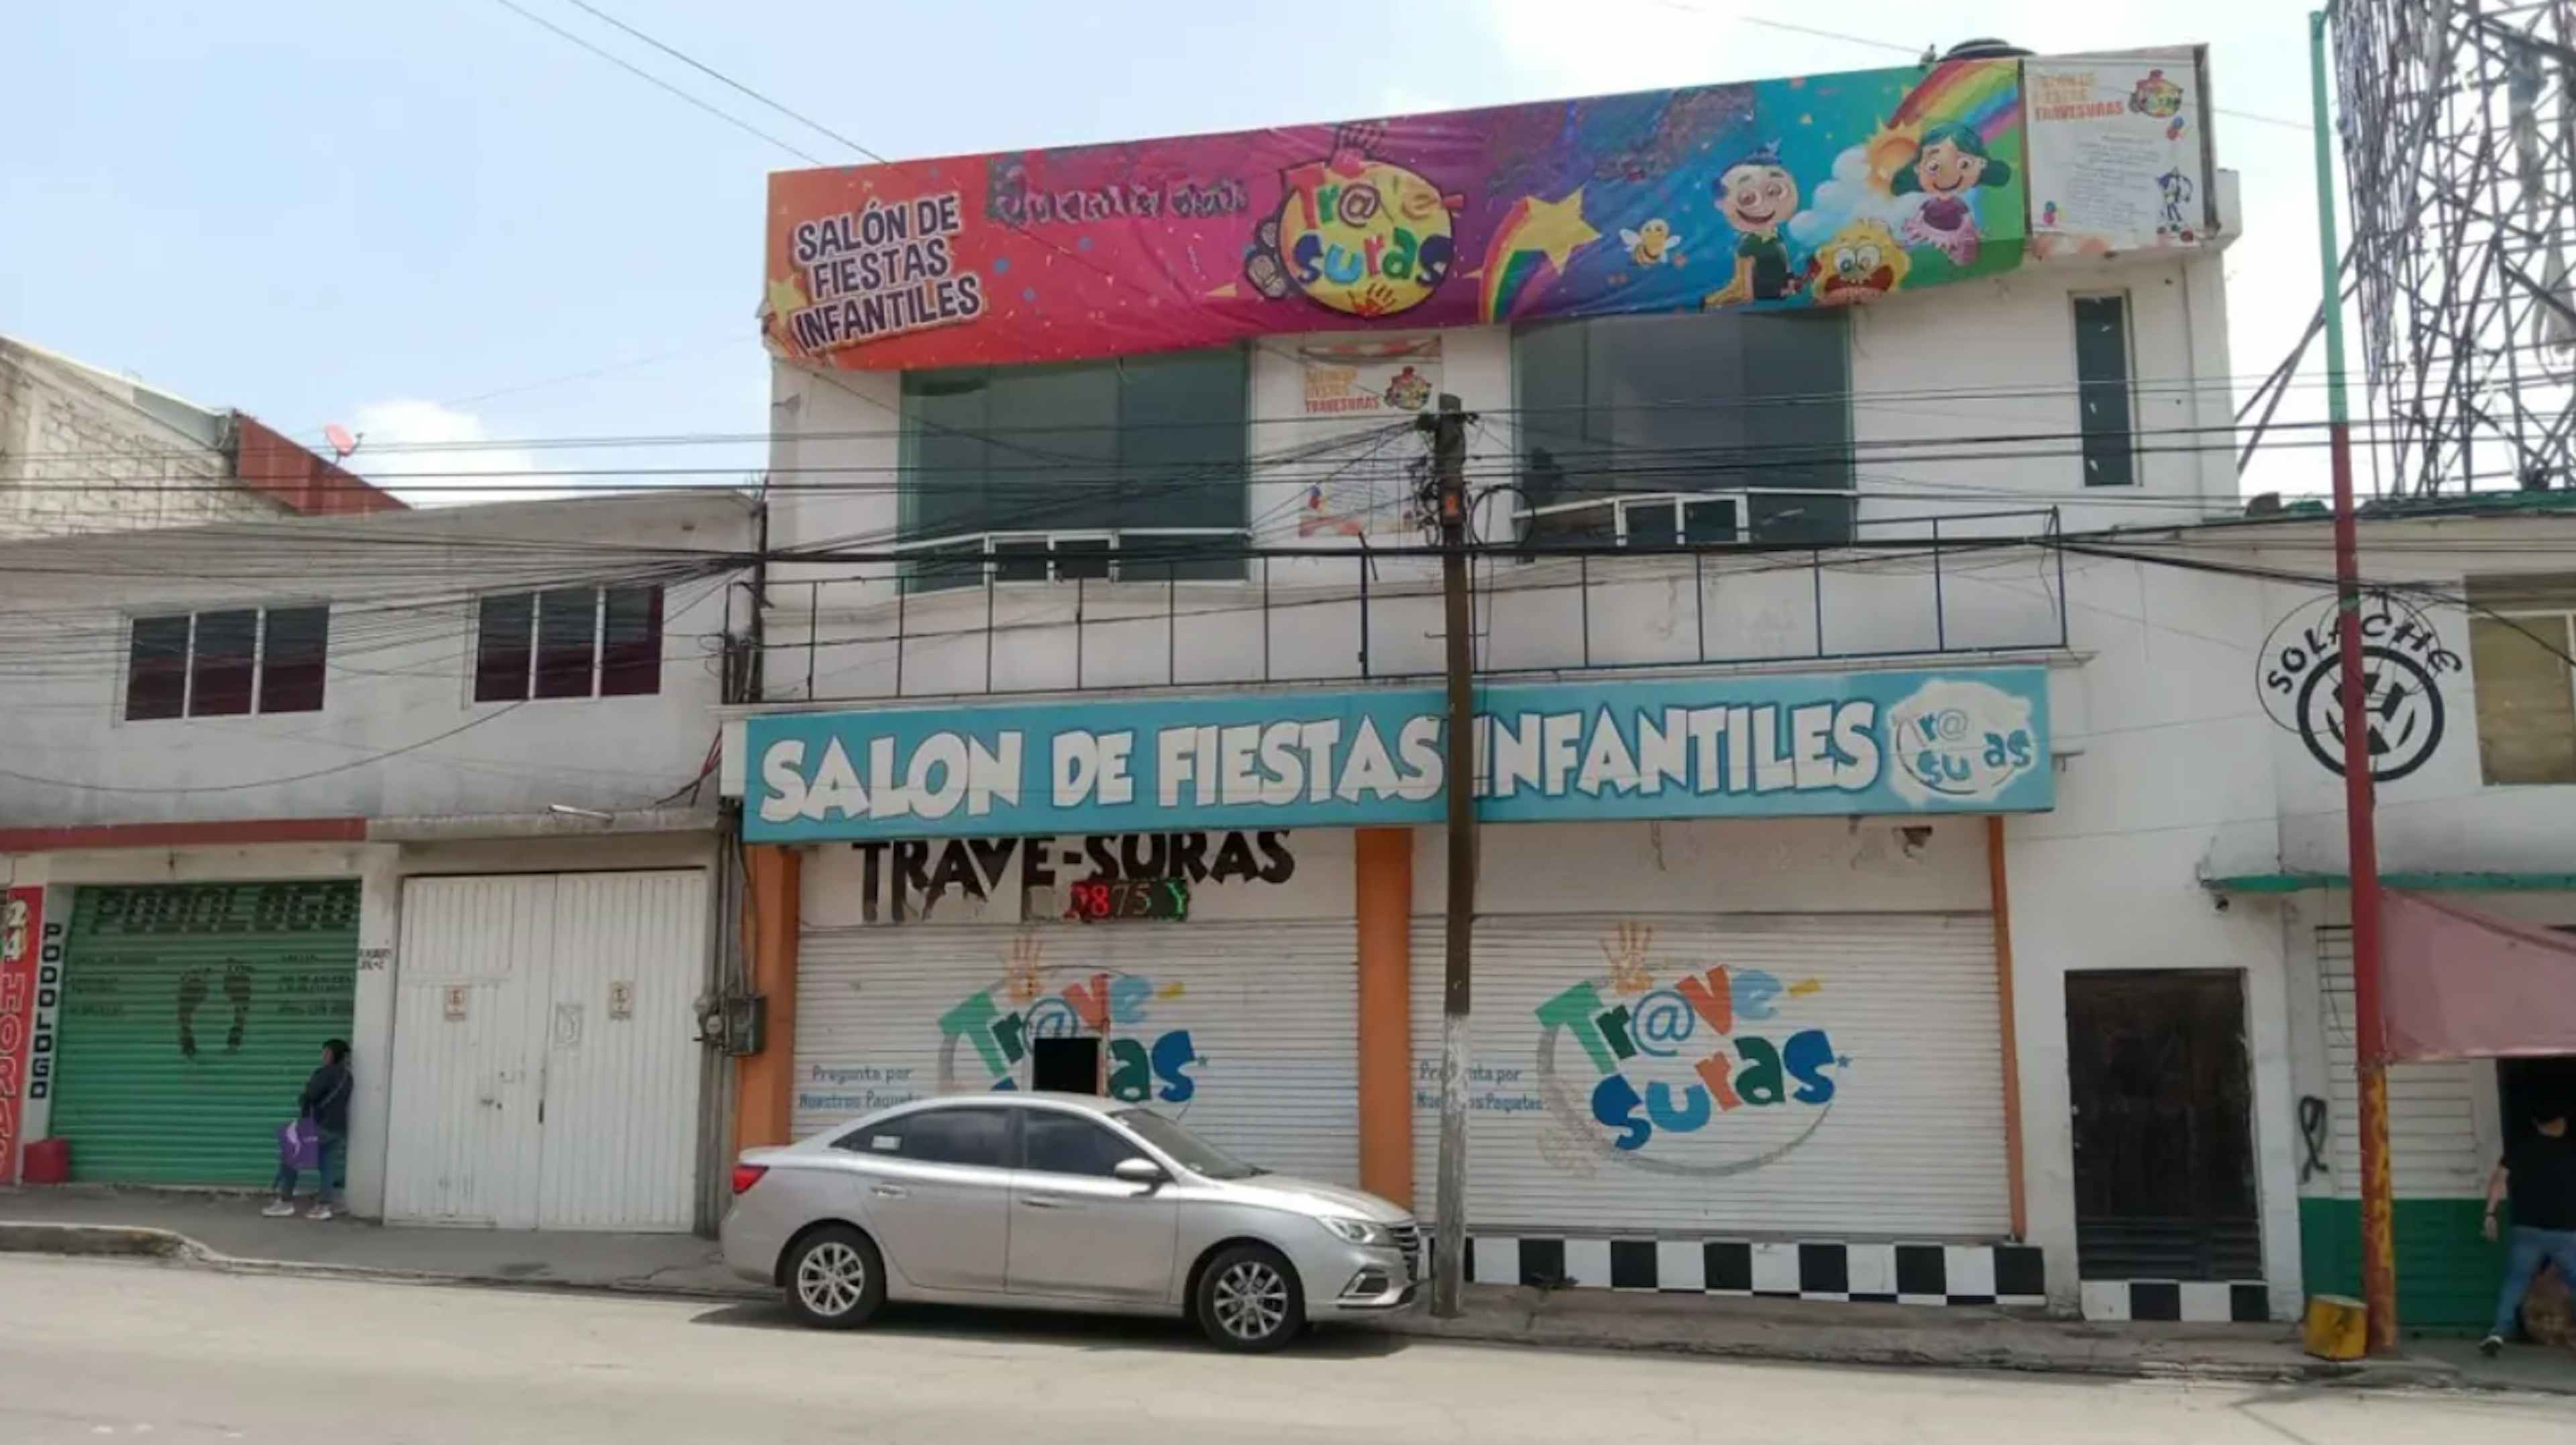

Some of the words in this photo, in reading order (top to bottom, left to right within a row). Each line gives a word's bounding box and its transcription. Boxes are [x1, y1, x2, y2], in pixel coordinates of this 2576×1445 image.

[796, 200, 907, 262] SALÓN
[918, 195, 960, 237] DE
[1295, 226, 1454, 287] suras
[813, 238, 949, 299] FIESTAS
[794, 275, 981, 353] INFANTILES
[759, 731, 1022, 825] SALON
[1052, 728, 1134, 806] DE
[1158, 713, 1444, 806] FIESTAS
[1471, 701, 1878, 798] INFANTILES
[30, 922, 62, 1099] PODOLOGO
[812, 1064, 881, 1085] Pregunta
[885, 1067, 914, 1085] por
[1496, 1069, 1524, 1085] por
[1591, 1029, 1836, 1150] suras
